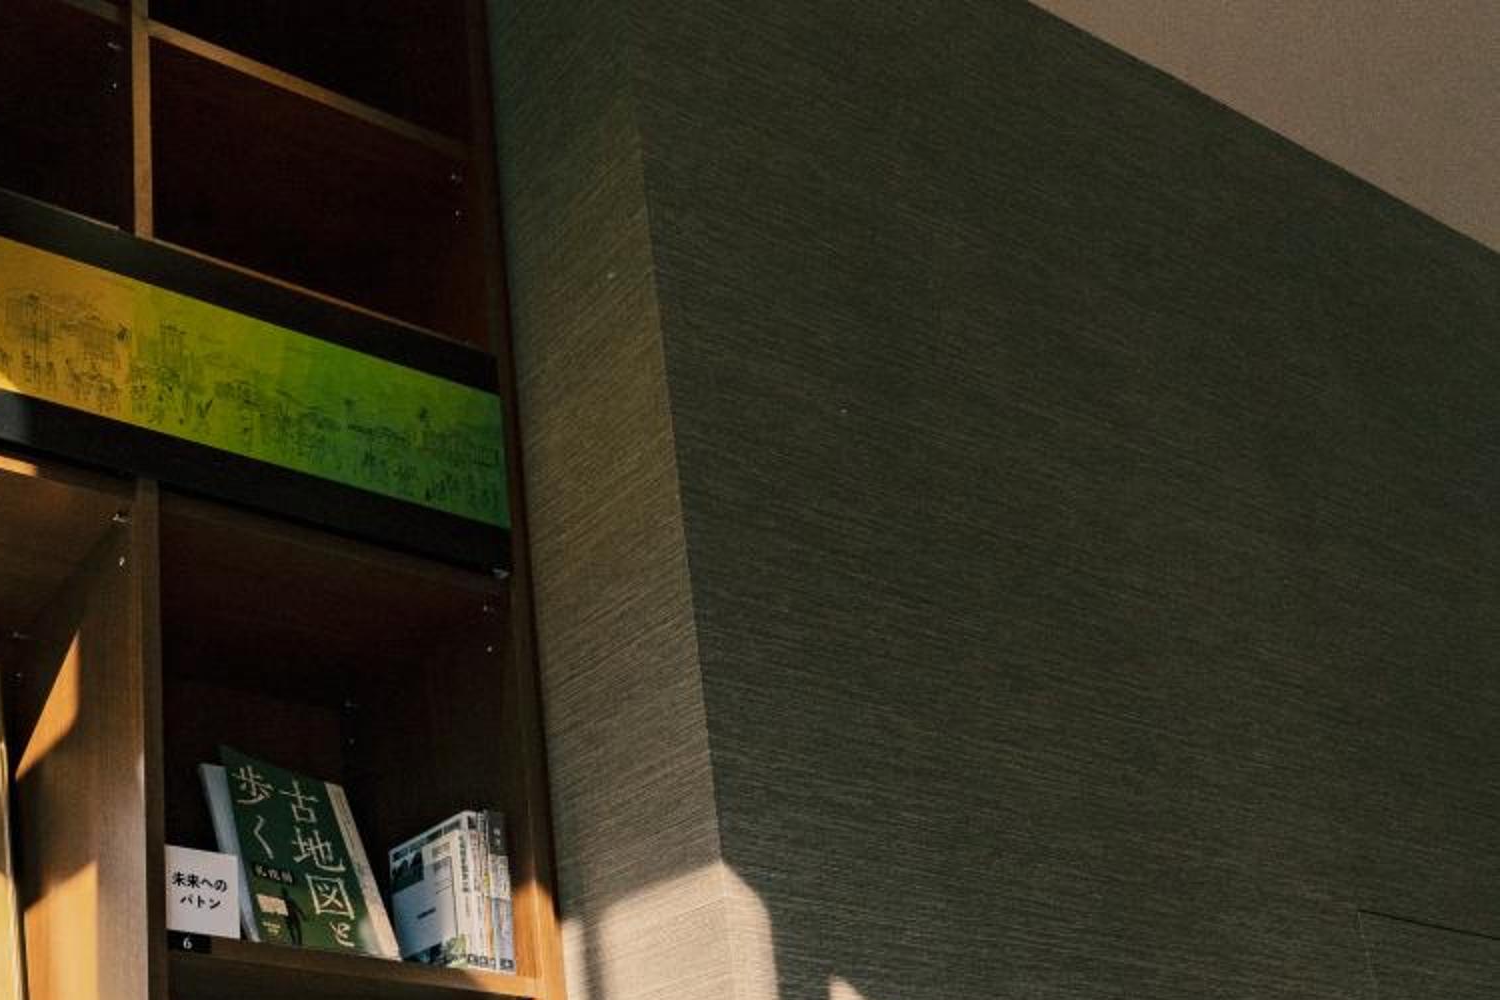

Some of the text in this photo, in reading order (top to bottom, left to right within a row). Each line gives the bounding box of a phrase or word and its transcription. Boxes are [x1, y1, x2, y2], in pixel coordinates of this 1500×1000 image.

[231, 766, 275, 860] 歩く
[279, 778, 356, 948] 古地図と
[171, 871, 228, 892] 未来への
[179, 894, 221, 911] バトン
[182, 937, 193, 949] 6
